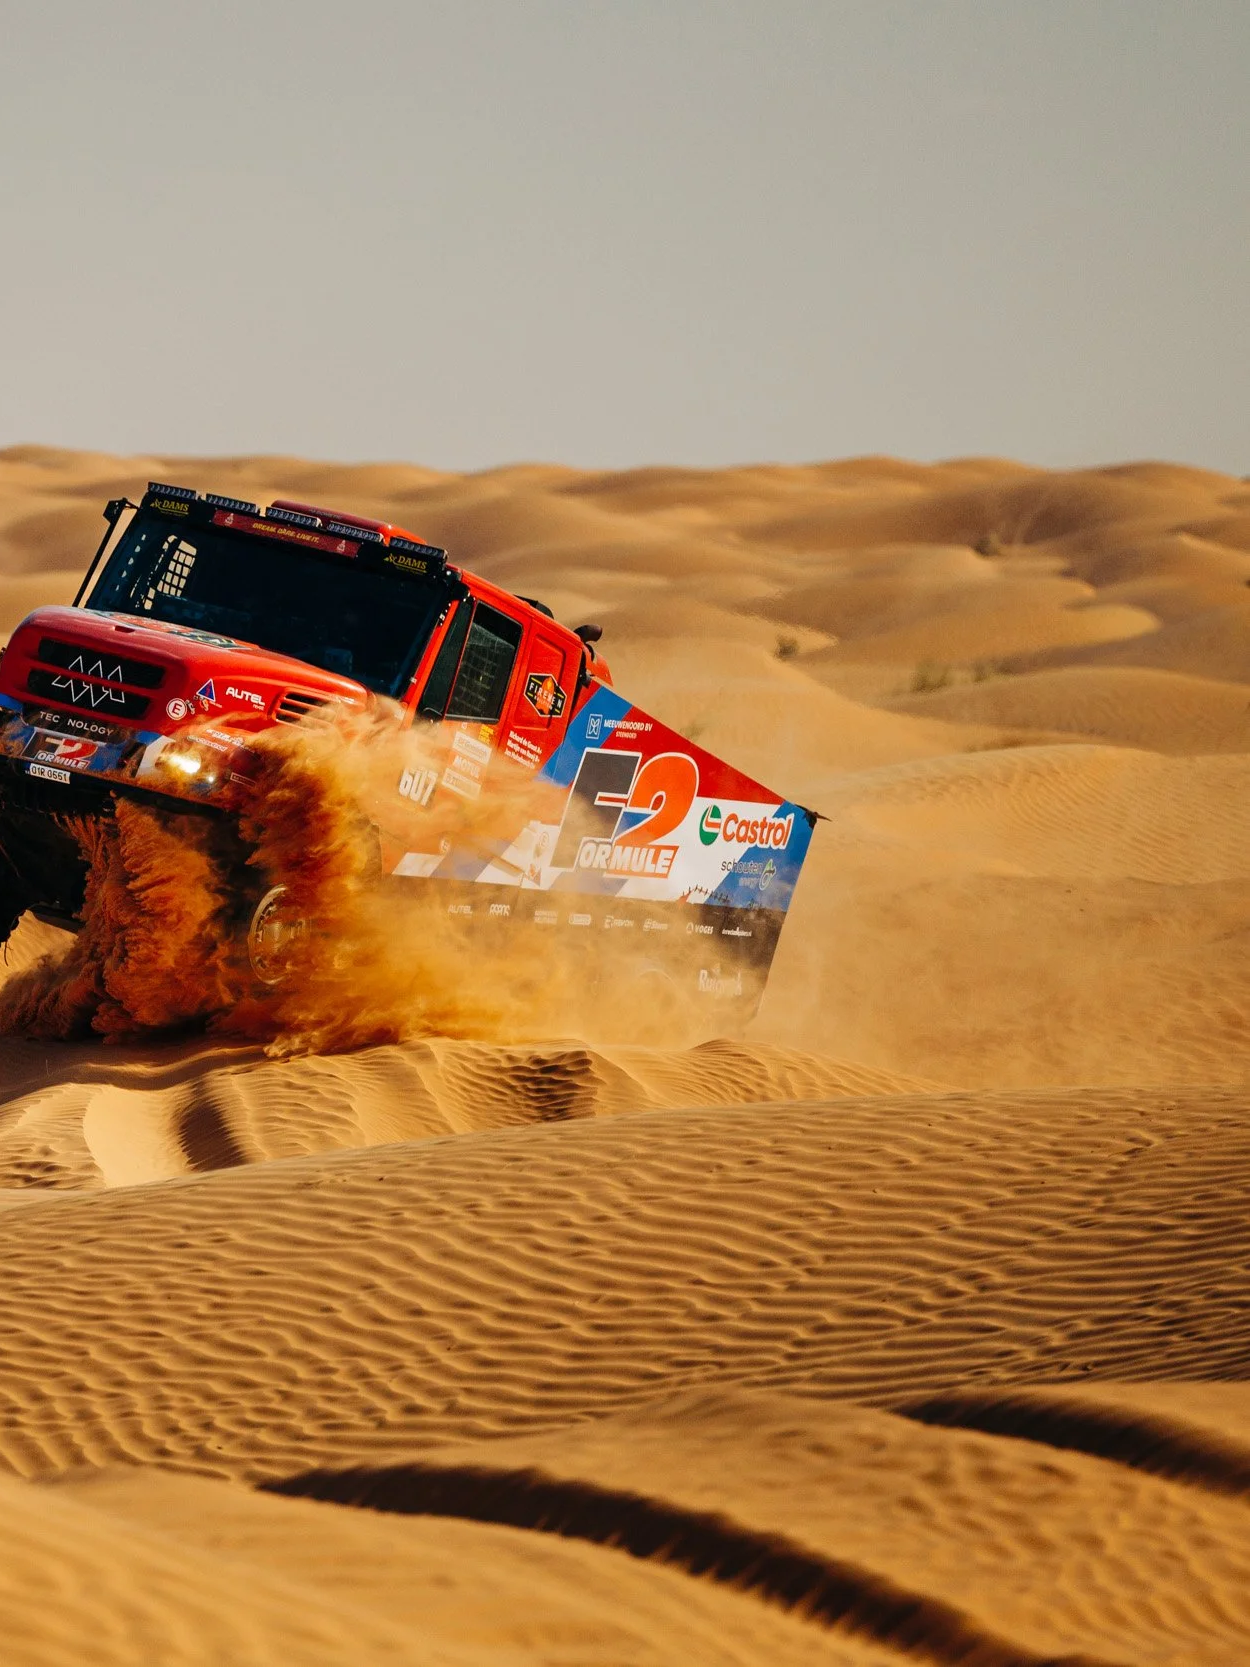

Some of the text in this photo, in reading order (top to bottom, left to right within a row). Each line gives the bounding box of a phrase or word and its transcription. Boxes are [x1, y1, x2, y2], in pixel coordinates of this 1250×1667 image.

[162, 500, 189, 512] DAMS
[398, 555, 428, 570] DAMS
[225, 686, 266, 706] AUTEL
[399, 766, 439, 806] 607
[722, 812, 793, 847] Castrol
[694, 924, 714, 935] VOGES
